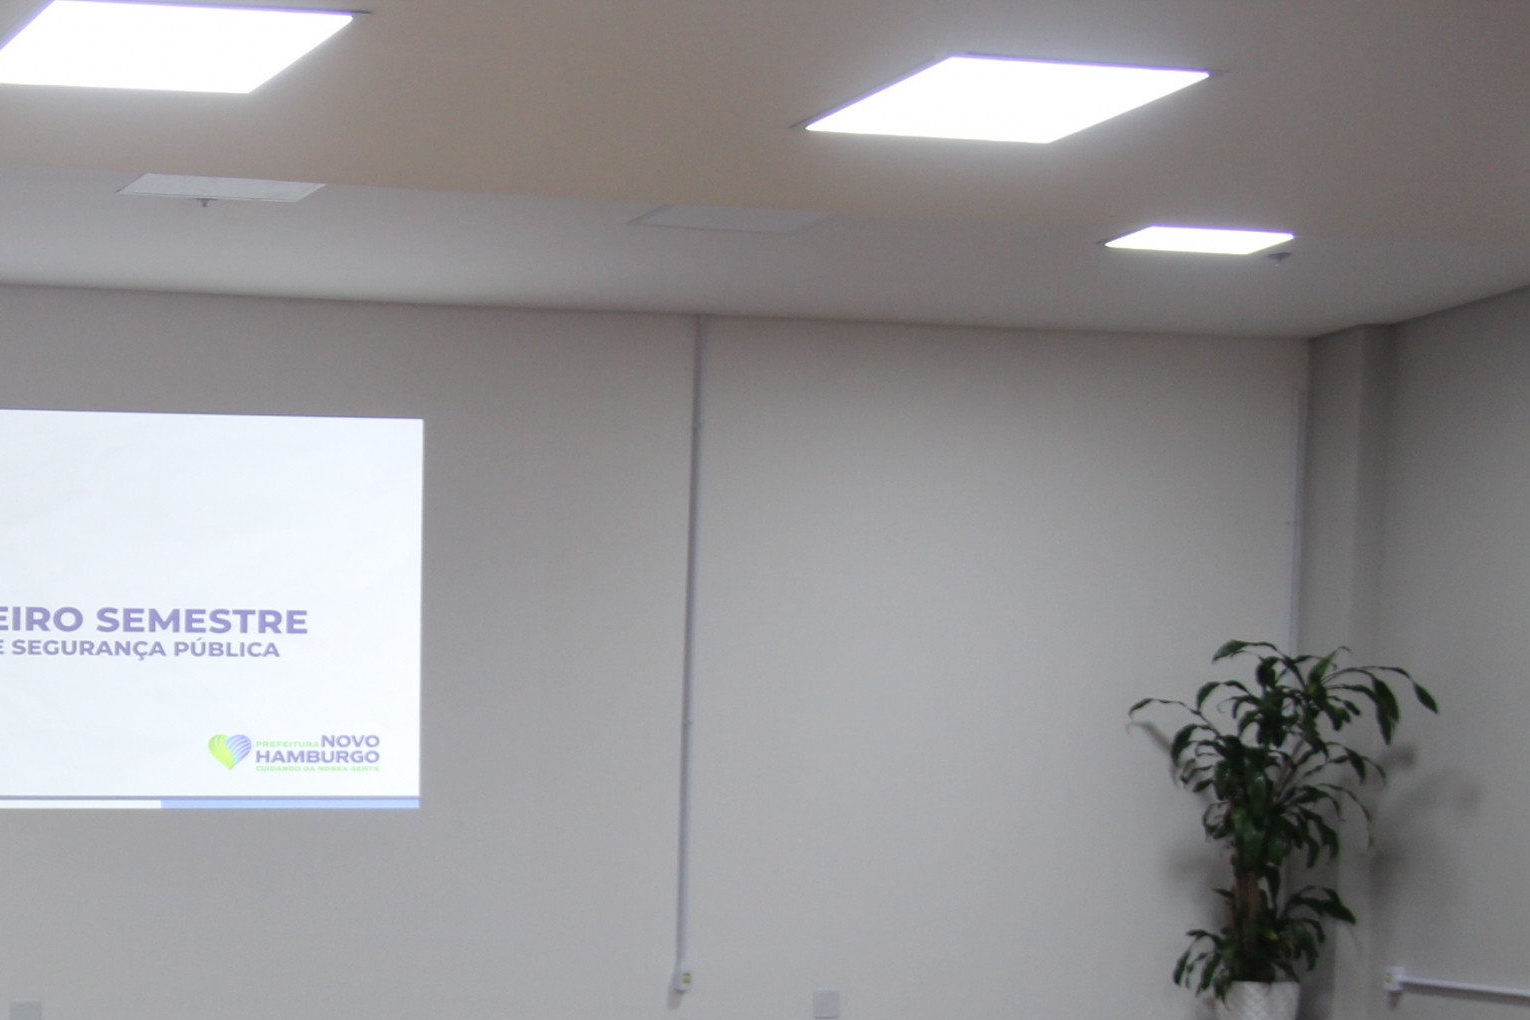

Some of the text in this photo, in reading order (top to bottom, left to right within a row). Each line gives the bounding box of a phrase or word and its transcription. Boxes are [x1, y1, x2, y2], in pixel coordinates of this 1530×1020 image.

[96, 606, 308, 634] SEMESTRE
[11, 638, 167, 661] SEGURANÇA
[174, 637, 281, 658] PÚBLICA
[256, 734, 380, 748] PREFEITURA NOVO
[255, 750, 380, 763] HAMBURGO
